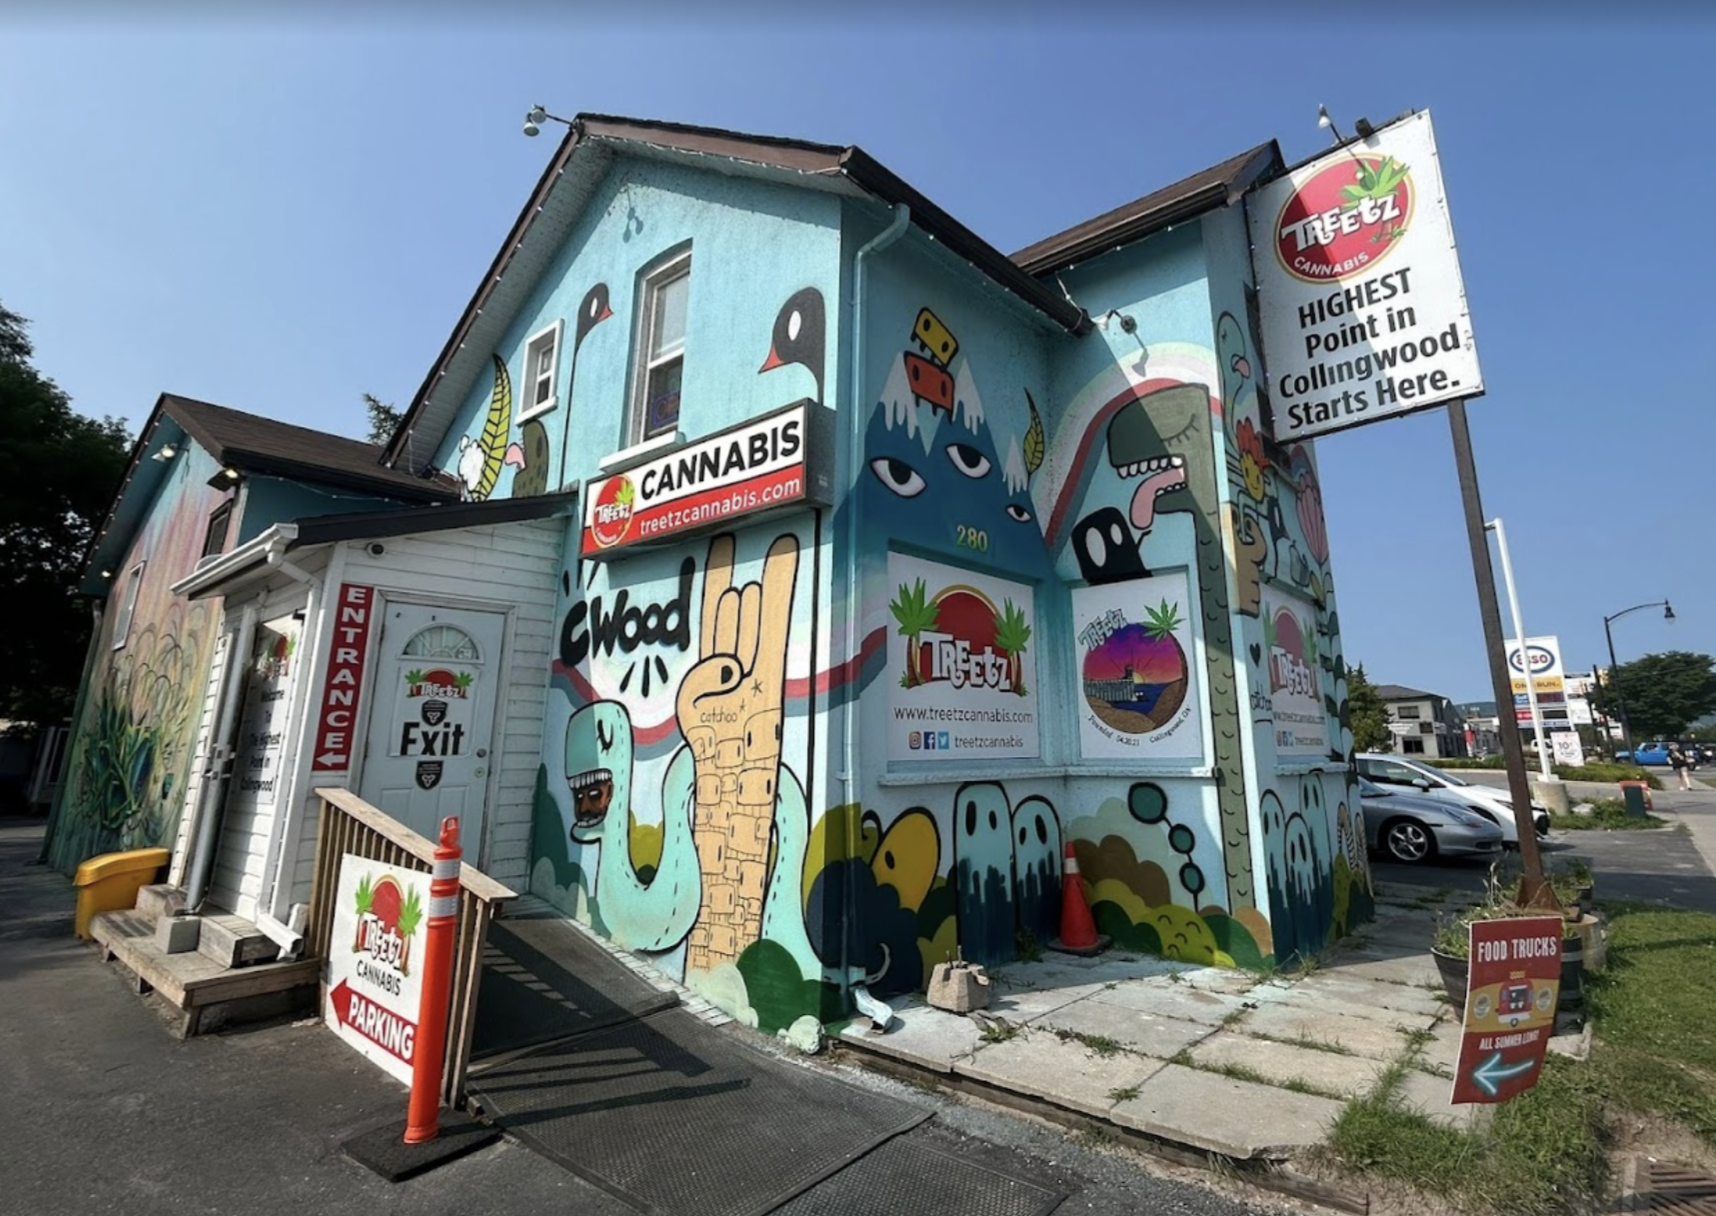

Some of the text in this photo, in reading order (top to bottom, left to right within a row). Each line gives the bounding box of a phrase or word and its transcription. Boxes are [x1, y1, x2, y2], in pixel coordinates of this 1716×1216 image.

[1294, 252, 1369, 276] CANNABIS
[1298, 267, 1411, 329] HIGHEST
[1305, 305, 1416, 359] Point in
[1279, 322, 1460, 399] Collingwood
[1287, 369, 1460, 430] Starts Here.
[640, 420, 800, 501] CANNABIS
[640, 476, 800, 536] treetzcannabis.com
[956, 525, 988, 553] 280
[324, 586, 367, 749] ENTRANCE
[893, 706, 1033, 724] www.treetzcannabis.com
[400, 721, 465, 756] Exit
[954, 736, 1024, 749] treetzcannabis
[1478, 936, 1557, 963] FOOD TRUCKS
[356, 959, 402, 997] CANNABIS
[348, 993, 414, 1060] PARKING
[1479, 1036, 1493, 1050] ALL
[1494, 1033, 1522, 1050] SUMMER
